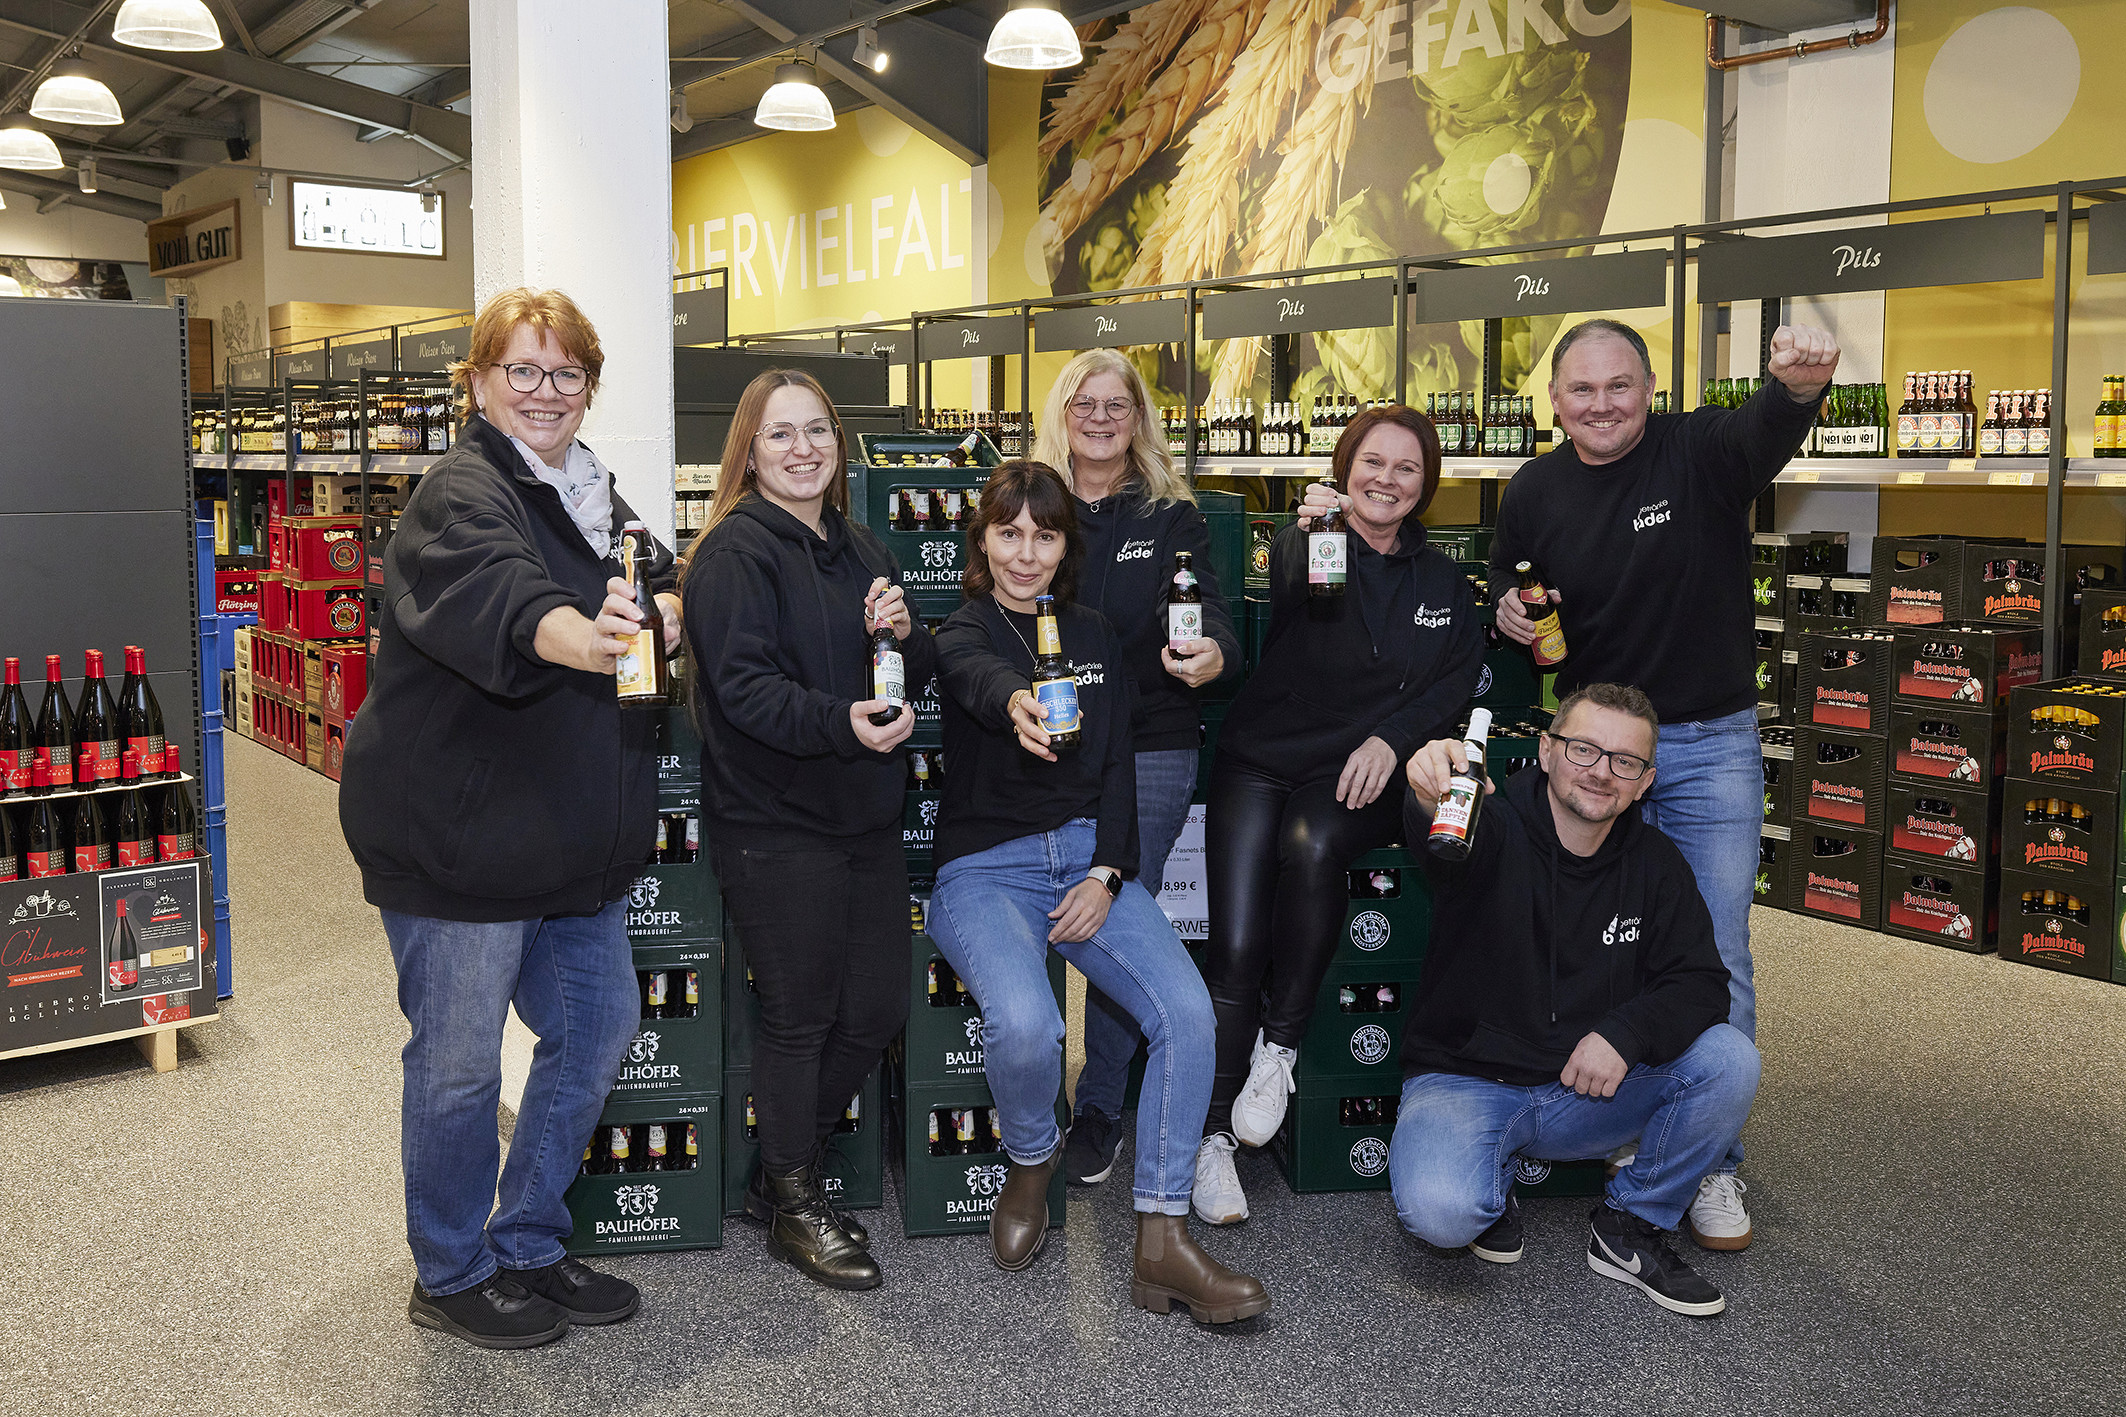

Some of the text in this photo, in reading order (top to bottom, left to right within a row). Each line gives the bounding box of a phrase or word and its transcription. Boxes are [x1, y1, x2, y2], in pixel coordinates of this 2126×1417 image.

[157, 226, 230, 270] VOLL GUT
[1833, 245, 1882, 278] Pils
[1514, 274, 1550, 301] Pils
[1277, 299, 1305, 322] Pils
[1095, 316, 1117, 338] Pils
[961, 329, 980, 348] Pils
[350, 495, 391, 505] ERNGER
[1312, 557, 1344, 569] fasnets
[1890, 585, 1942, 602] Palmbräu
[218, 599, 258, 612] Flötzing
[1984, 594, 2041, 617] Palmbräu
[1414, 613, 1452, 629] bader
[1073, 662, 1103, 674] getränke
[1913, 659, 1970, 678] Palmbräu
[1816, 686, 1869, 704] Palmbräu
[1910, 737, 1967, 757] Palmbräu
[2030, 750, 2094, 774] Palmbräu
[1812, 779, 1864, 799] Palmbräu
[1441, 807, 1468, 817] TANNEN
[1907, 815, 1964, 836] Palmbräu
[1175, 846, 1199, 854] Fasnets
[2025, 842, 2088, 865] Palmbräu
[1189, 881, 1197, 891] €
[1808, 871, 1859, 893] Palmbräu
[1903, 891, 1959, 913] Palmbräu
[1352, 912, 1388, 931] Alpirsbacher
[1, 927, 88, 967] Glühwein
[2021, 932, 2085, 955] Palmbräu
[28, 972, 58, 981] ORIGINALEM
[58, 969, 76, 977] REZEPT
[1352, 1027, 1389, 1046] Alpirsbacher
[1352, 1139, 1388, 1158] Alpirsbacher
[595, 1216, 681, 1235] BAUHÖFER
[608, 1234, 669, 1243] FAMILIENBRAUEREI
